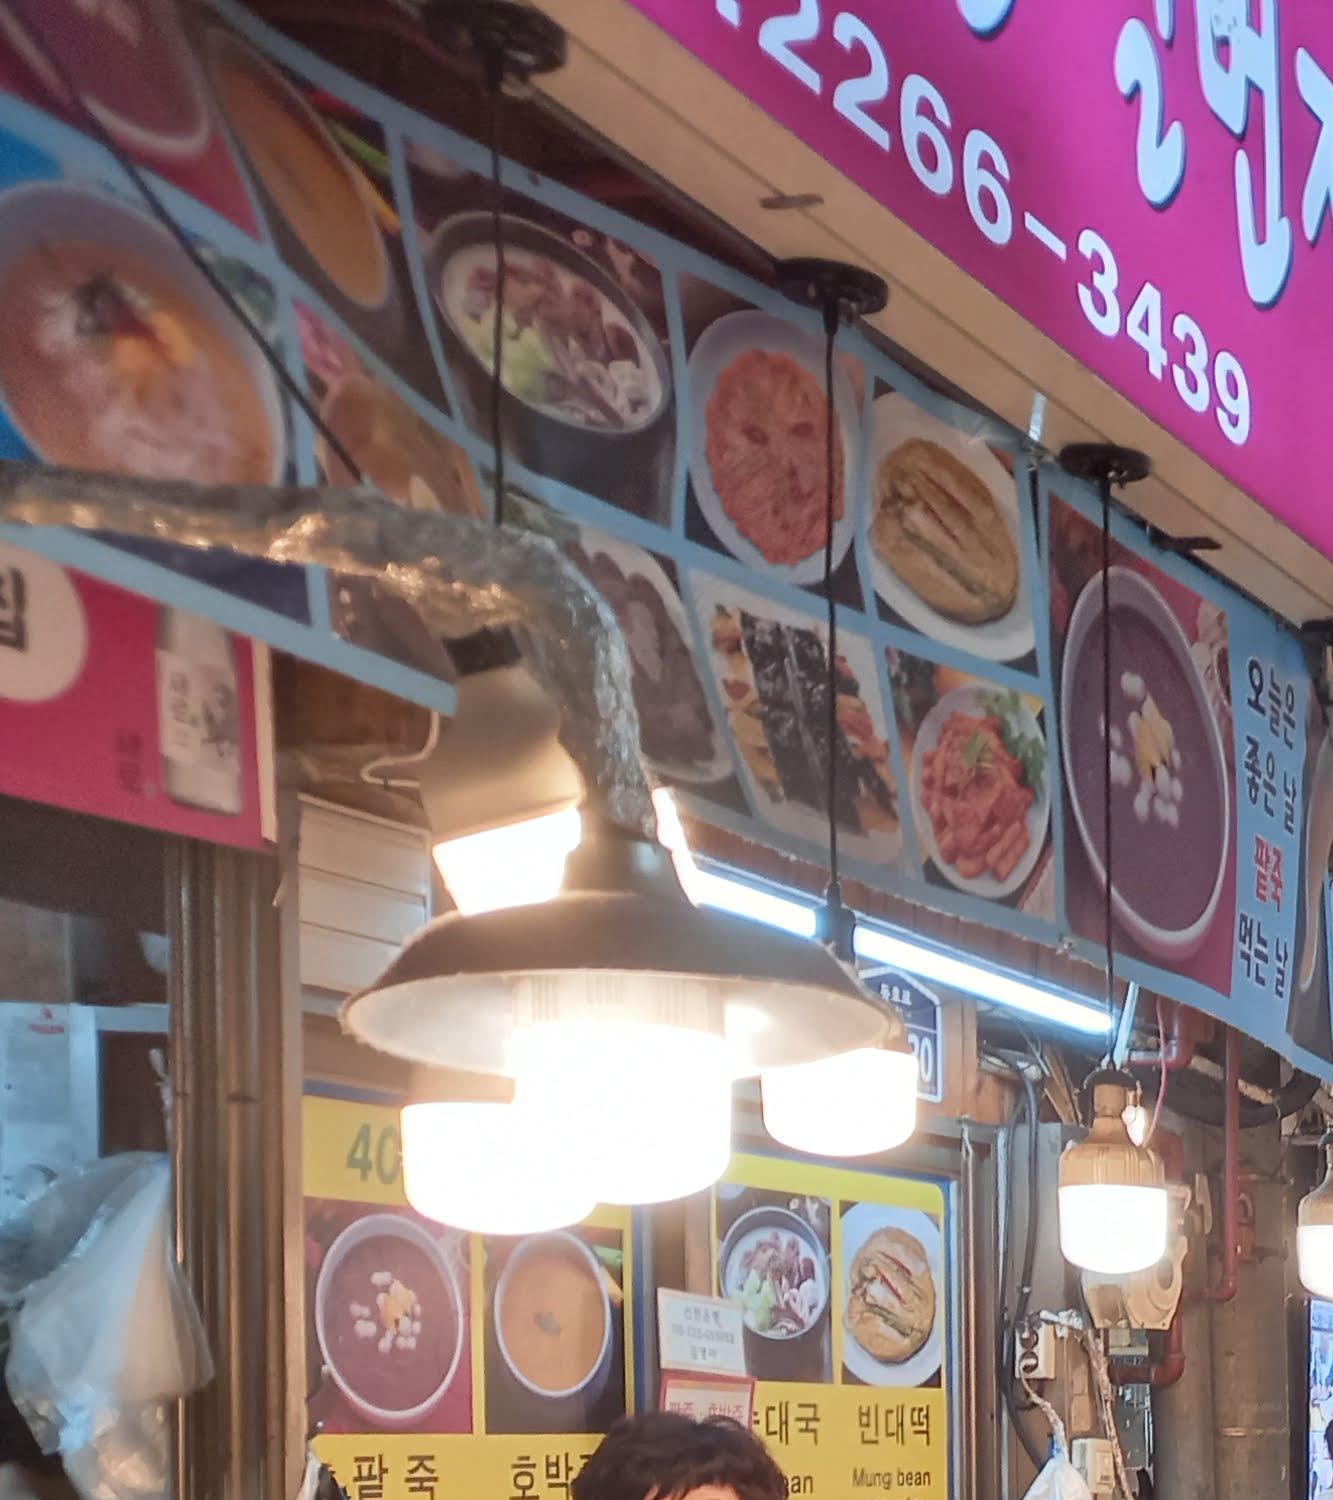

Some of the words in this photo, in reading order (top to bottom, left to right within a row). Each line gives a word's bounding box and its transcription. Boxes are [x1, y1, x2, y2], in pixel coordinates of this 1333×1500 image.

[753, 1401, 821, 1446] 대국
[858, 1403, 931, 1446] 빈대떡
[852, 1467, 892, 1490] Mung
[896, 1470, 931, 1488] bean
